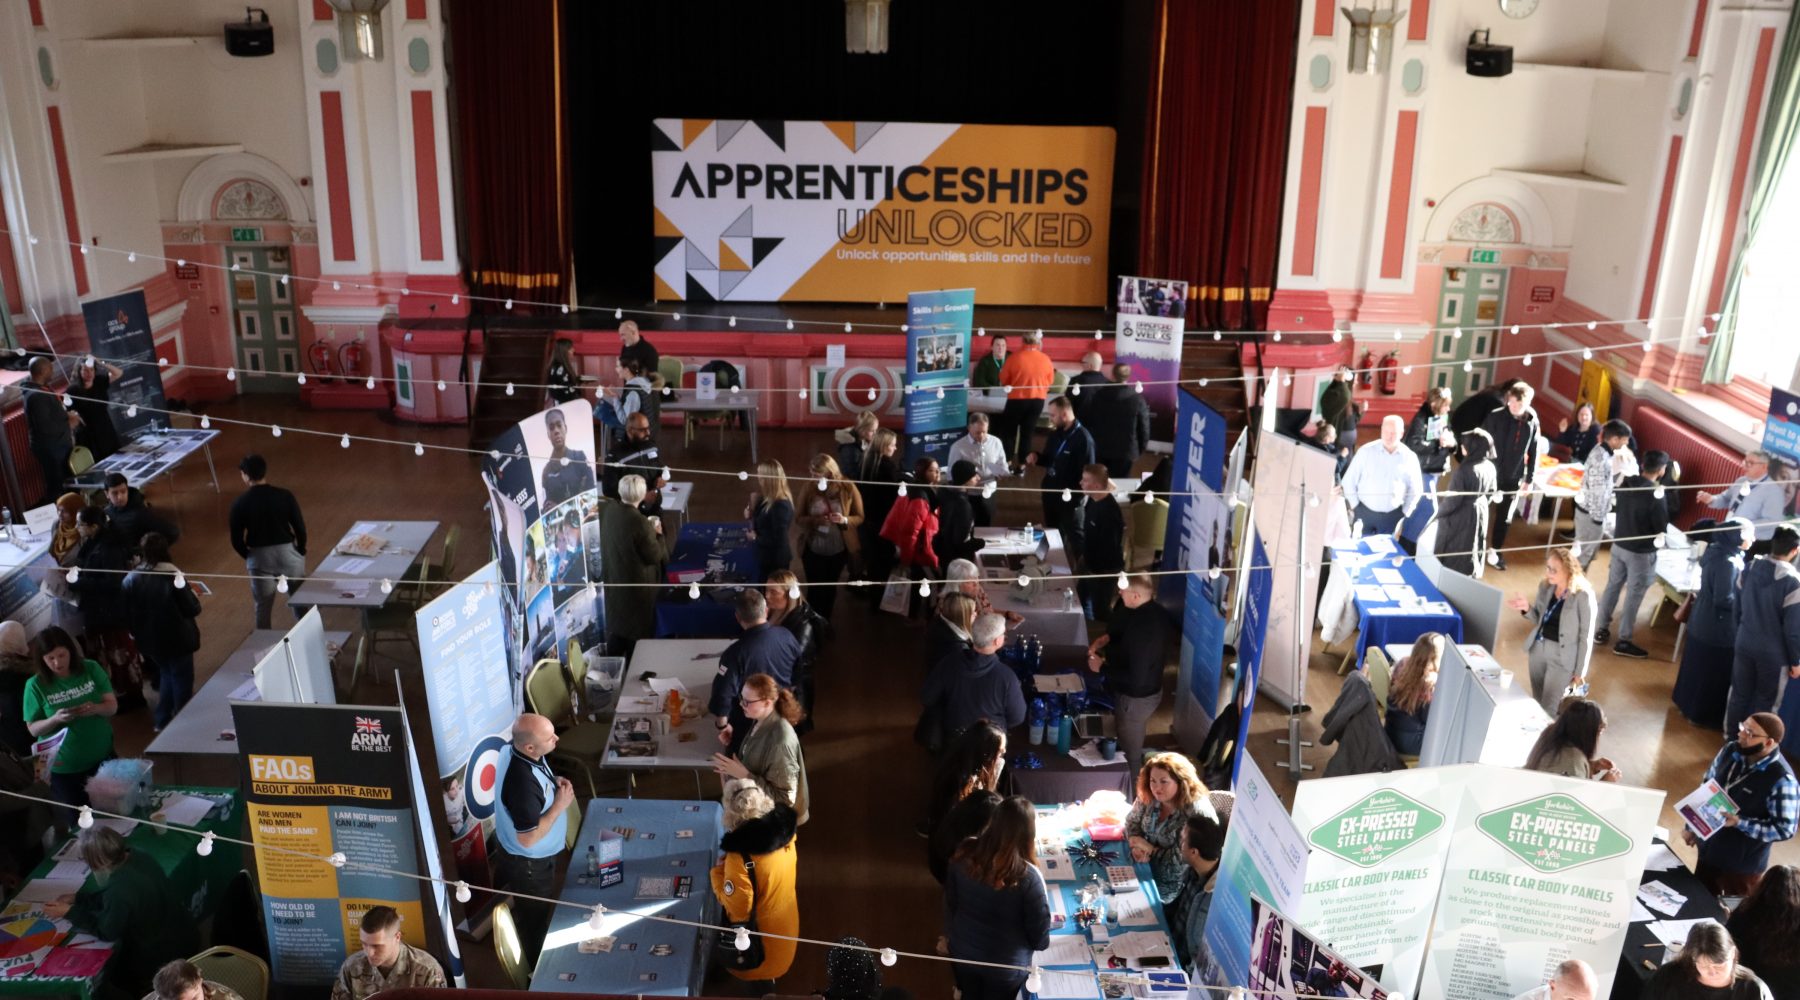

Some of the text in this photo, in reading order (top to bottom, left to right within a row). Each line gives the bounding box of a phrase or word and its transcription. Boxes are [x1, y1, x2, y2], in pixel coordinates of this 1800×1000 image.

[670, 161, 1089, 206] APPRENTICESHIPS
[837, 208, 1092, 248] UNLOCKED
[836, 248, 878, 261] Unlock
[968, 252, 998, 264] skills
[1002, 252, 1026, 264] and
[1029, 252, 1050, 264] the
[1053, 253, 1092, 265] future
[912, 306, 932, 314] Skills
[944, 304, 970, 312] Growth
[456, 630, 473, 646] YOUR
[474, 617, 492, 633] ROLE
[47, 680, 95, 702] MACMILLAN
[352, 733, 391, 746] ARMY
[252, 758, 312, 780] FAQs
[255, 784, 389, 798] ABOUT JOINING THE ARMY
[258, 818, 274, 826] AND
[338, 812, 352, 820] AM
[353, 813, 368, 821] NOT
[369, 814, 397, 822] BRITISH
[357, 821, 376, 829] JOIN?
[1339, 810, 1418, 836] EX-PRESSED
[260, 826, 277, 834] PAID
[1510, 812, 1601, 842] EX-PRESSED
[1337, 828, 1414, 848] STEEL PANELS
[1508, 832, 1596, 855] STEEL PANELS
[1302, 868, 1428, 894] CLASSIC CAR BODY PANELS
[1468, 868, 1614, 903] CLASSIC CAR BODY PANELS
[1336, 893, 1377, 905] specialise
[1389, 888, 1404, 896] the
[1463, 886, 1611, 918] We produce replacement panels
[1322, 902, 1379, 916] manufacture
[1322, 916, 1348, 925] range
[1360, 907, 1416, 919] discontinued
[1460, 896, 1482, 905] close
[1496, 902, 1511, 910] the
[1513, 905, 1550, 918] original
[1563, 914, 1600, 926] possible
[1320, 920, 1394, 935] and unobtainable
[1469, 908, 1493, 917] stock
[1509, 915, 1554, 926] extensive
[1556, 923, 1583, 932] range
[1356, 930, 1382, 942] panels
[1501, 923, 1538, 935] original
[1541, 929, 1564, 939] body
[1339, 940, 1379, 952] produced
